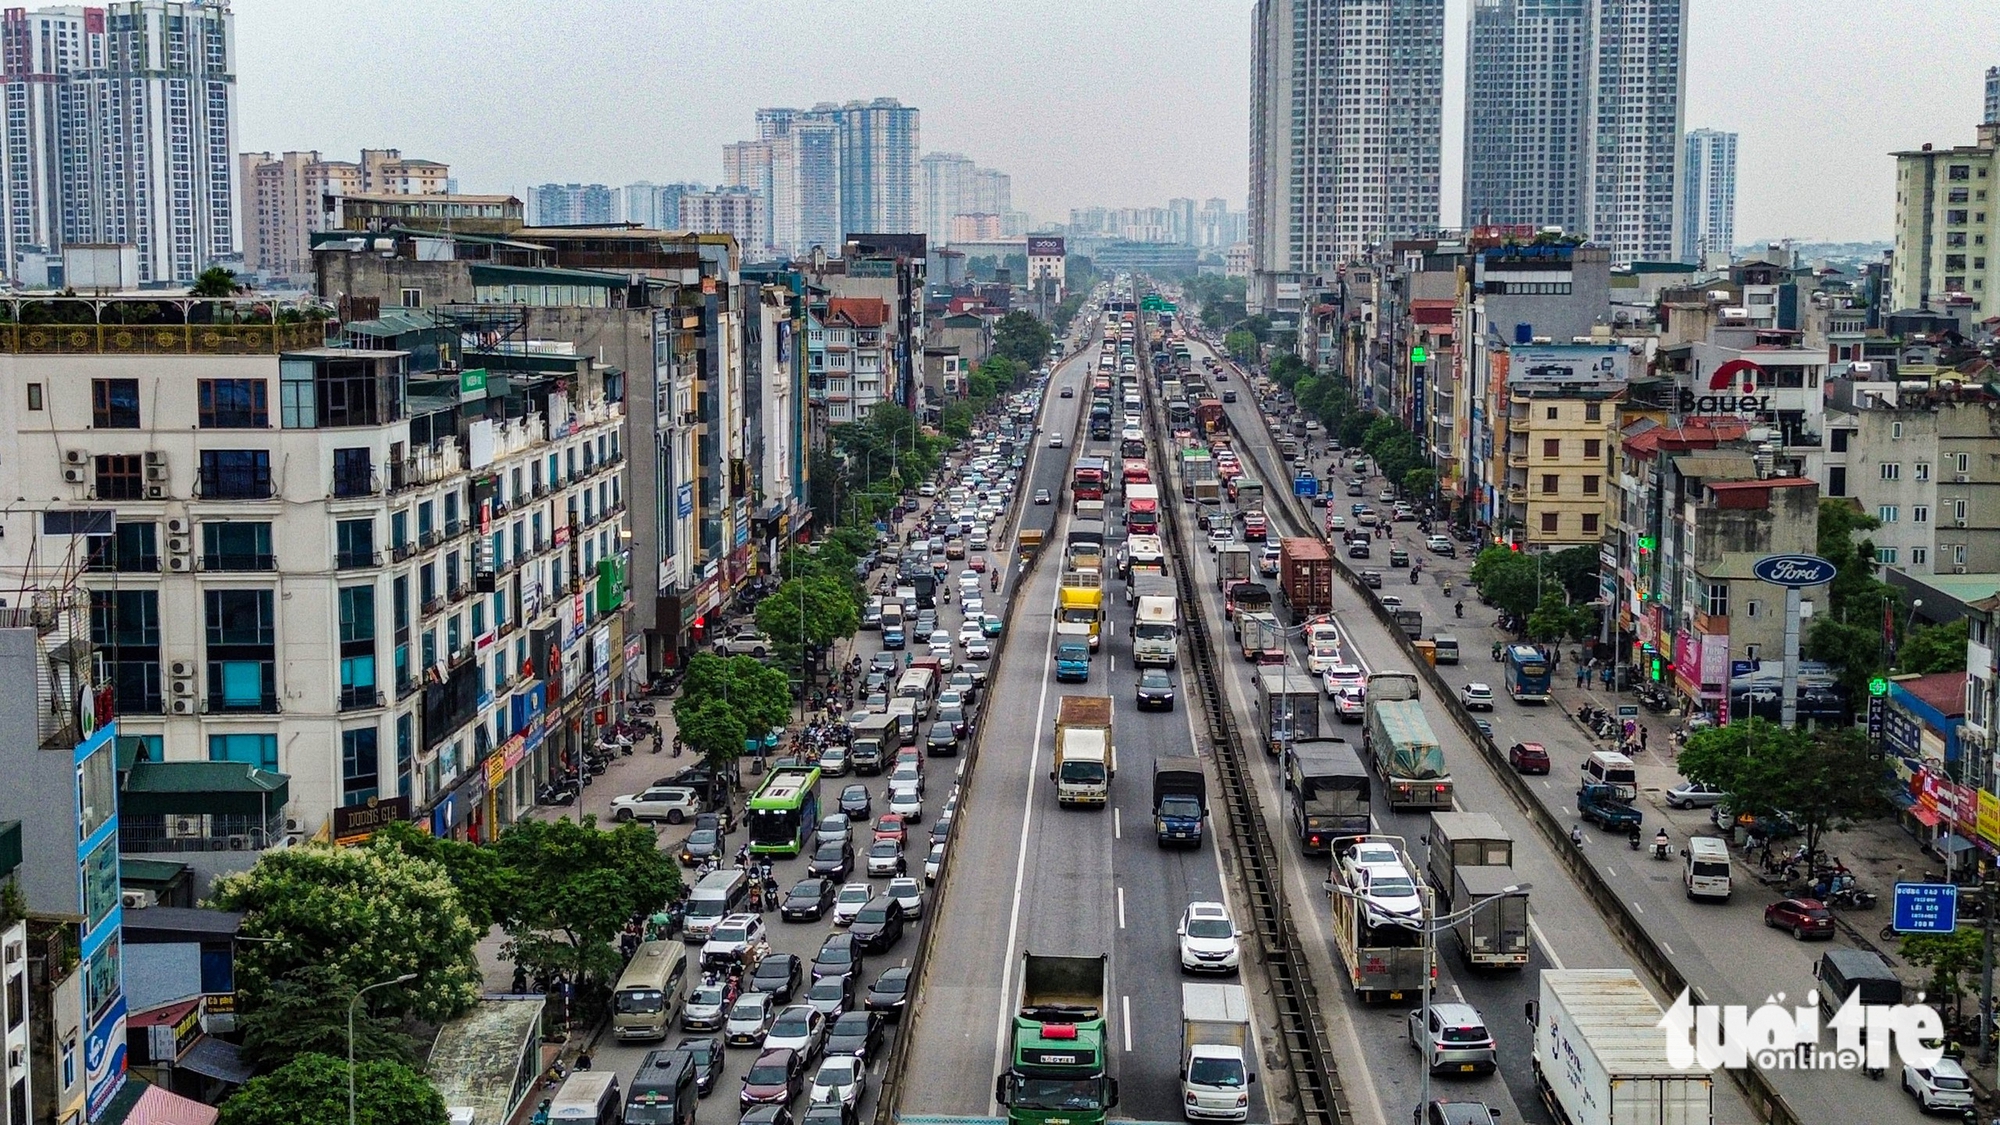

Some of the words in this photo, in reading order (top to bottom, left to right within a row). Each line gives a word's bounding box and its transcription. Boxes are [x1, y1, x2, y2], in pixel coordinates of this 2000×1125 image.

[1452, 317, 1461, 380] HOTEL
[1679, 387, 1770, 412] Bauer
[1770, 560, 1821, 580] Ford
